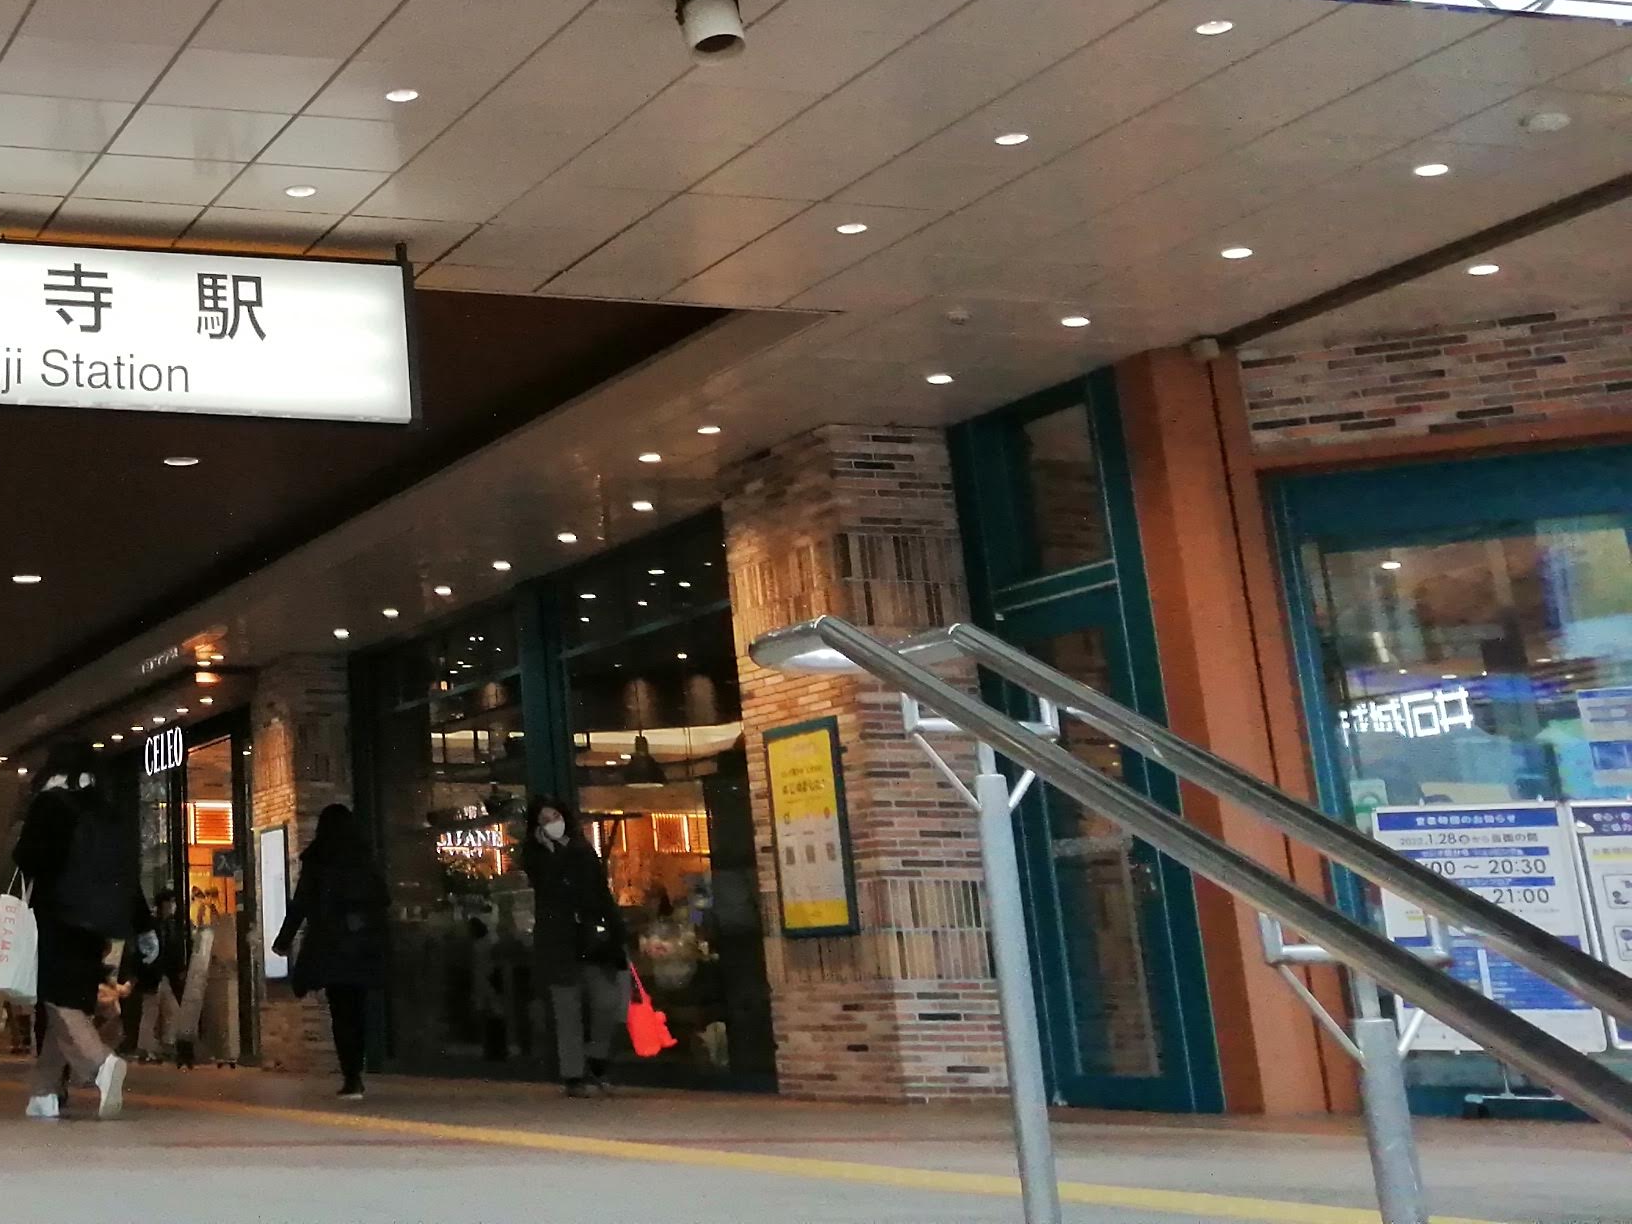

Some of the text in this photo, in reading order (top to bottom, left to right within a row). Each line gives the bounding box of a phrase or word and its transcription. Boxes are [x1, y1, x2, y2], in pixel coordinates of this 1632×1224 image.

[41, 349, 190, 393] Station
[145, 726, 183, 777] CELEO
[1488, 858, 1547, 875] 20:30
[1493, 887, 1550, 904] 21:00
